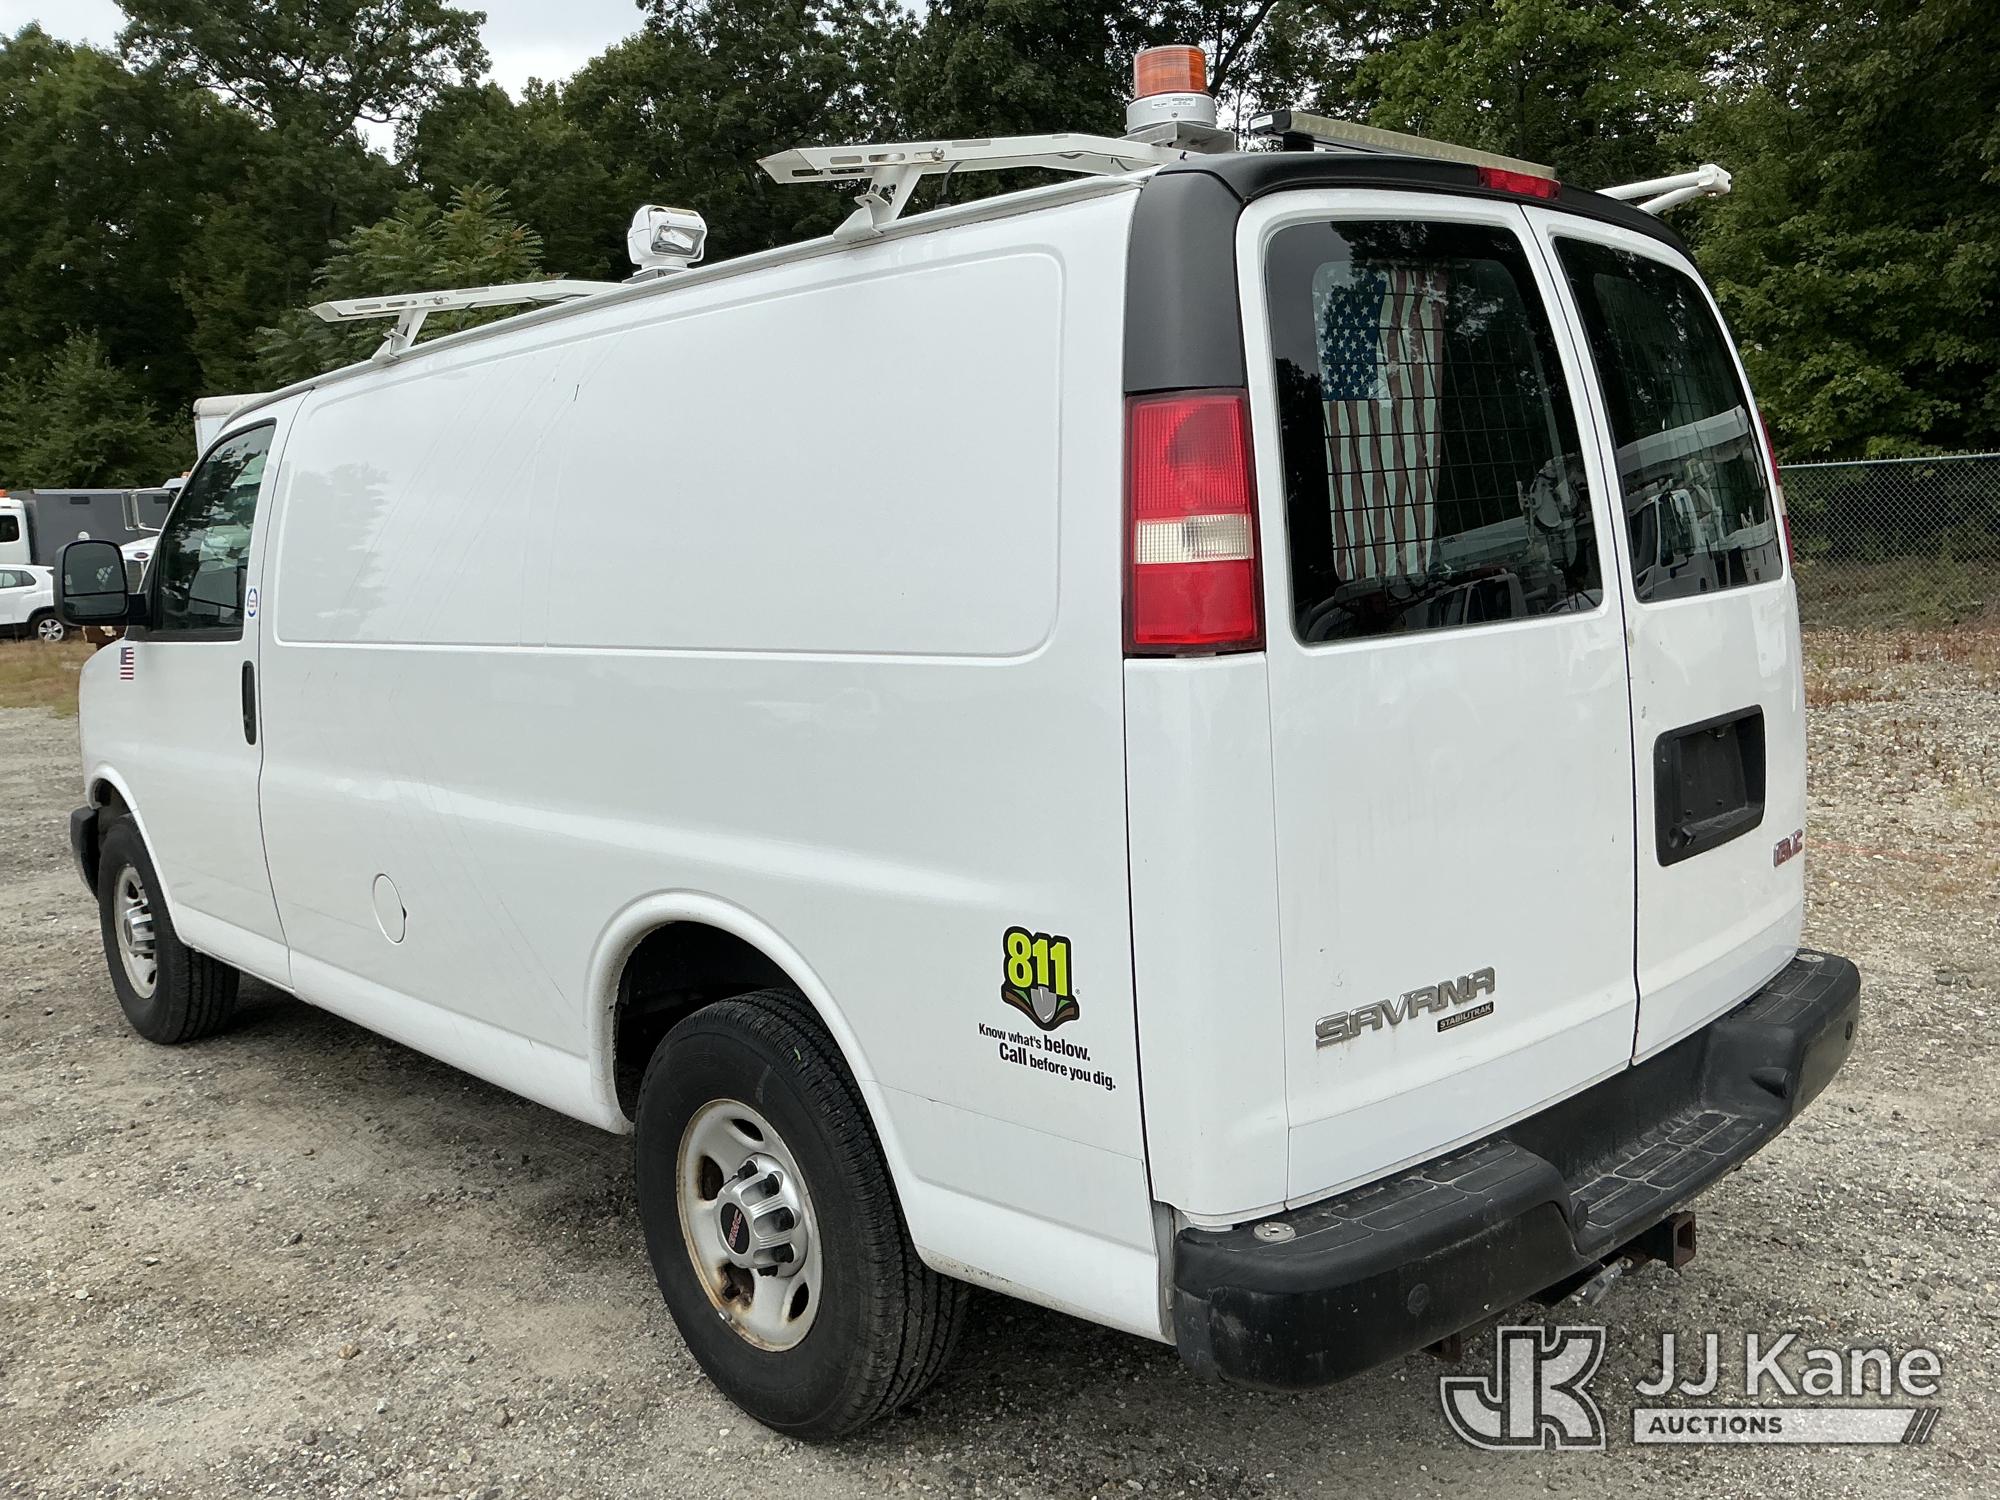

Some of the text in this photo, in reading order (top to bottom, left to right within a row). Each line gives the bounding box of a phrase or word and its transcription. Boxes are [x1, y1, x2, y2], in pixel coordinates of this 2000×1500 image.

[1007, 932, 1068, 997] 811
[1315, 966, 1496, 1050] SAVANA
[1439, 1003, 1493, 1030] STABILITRAK
[978, 1022, 1091, 1062] Know what's below.
[999, 1042, 1116, 1091] Call before you dig.
